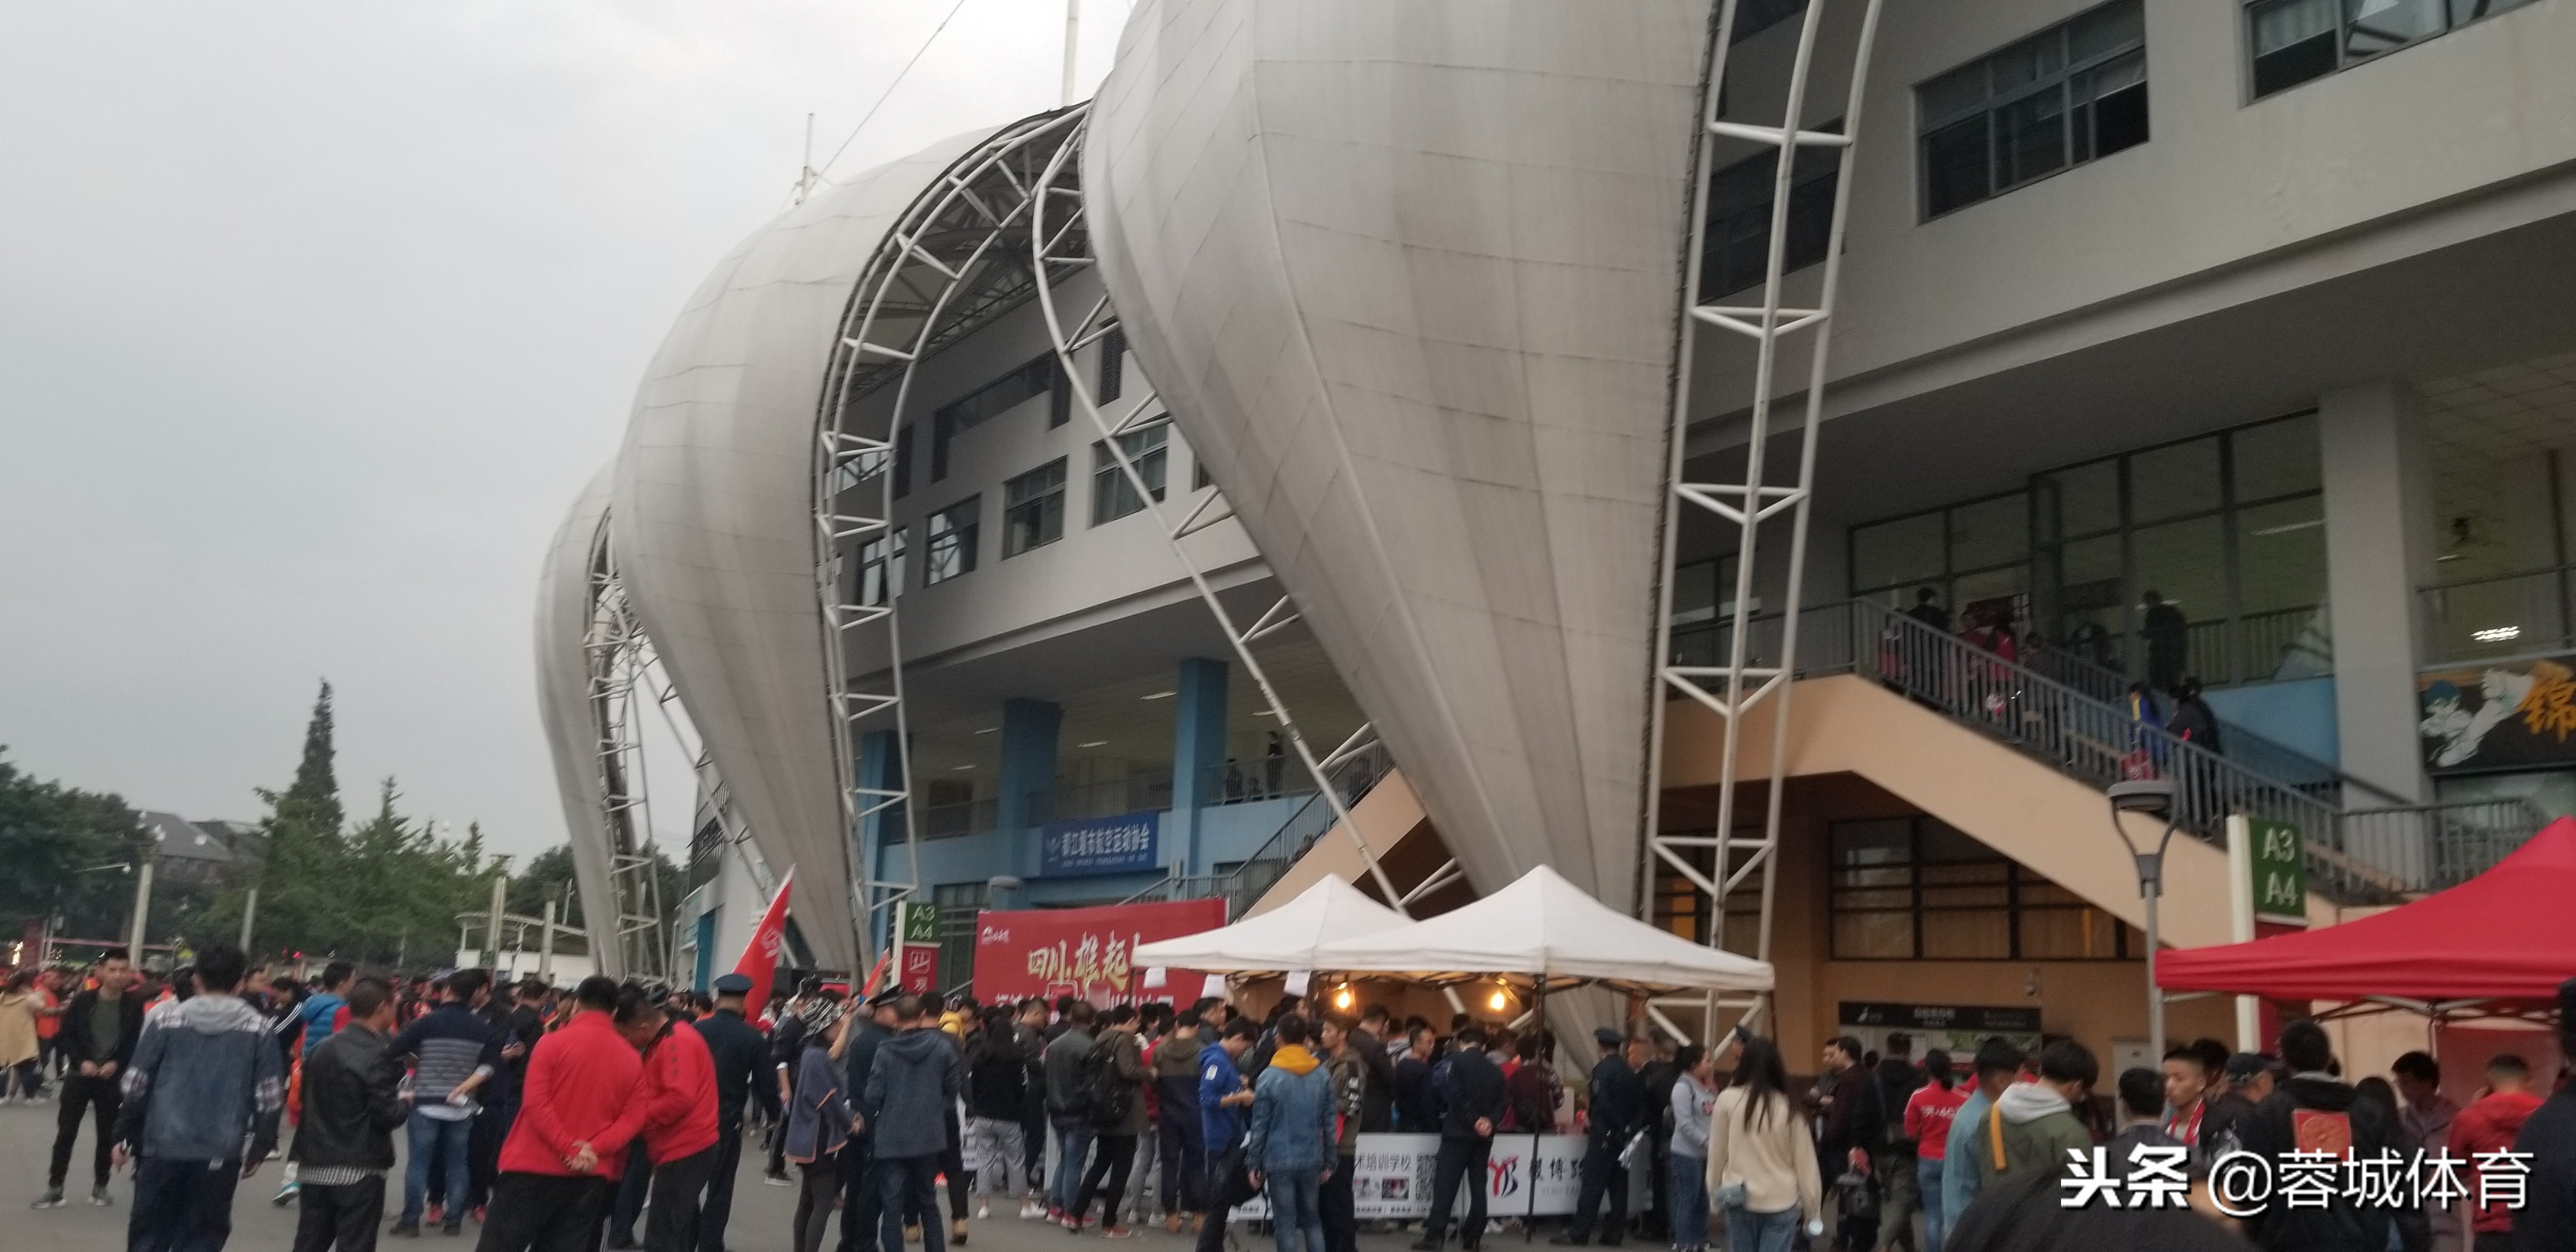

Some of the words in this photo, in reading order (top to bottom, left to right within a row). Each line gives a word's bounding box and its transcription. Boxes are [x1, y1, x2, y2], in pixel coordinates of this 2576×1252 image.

[2262, 827, 2295, 863] A3
[2266, 871, 2299, 908] A4
[912, 905, 935, 922] A3
[910, 924, 934, 940] A4
